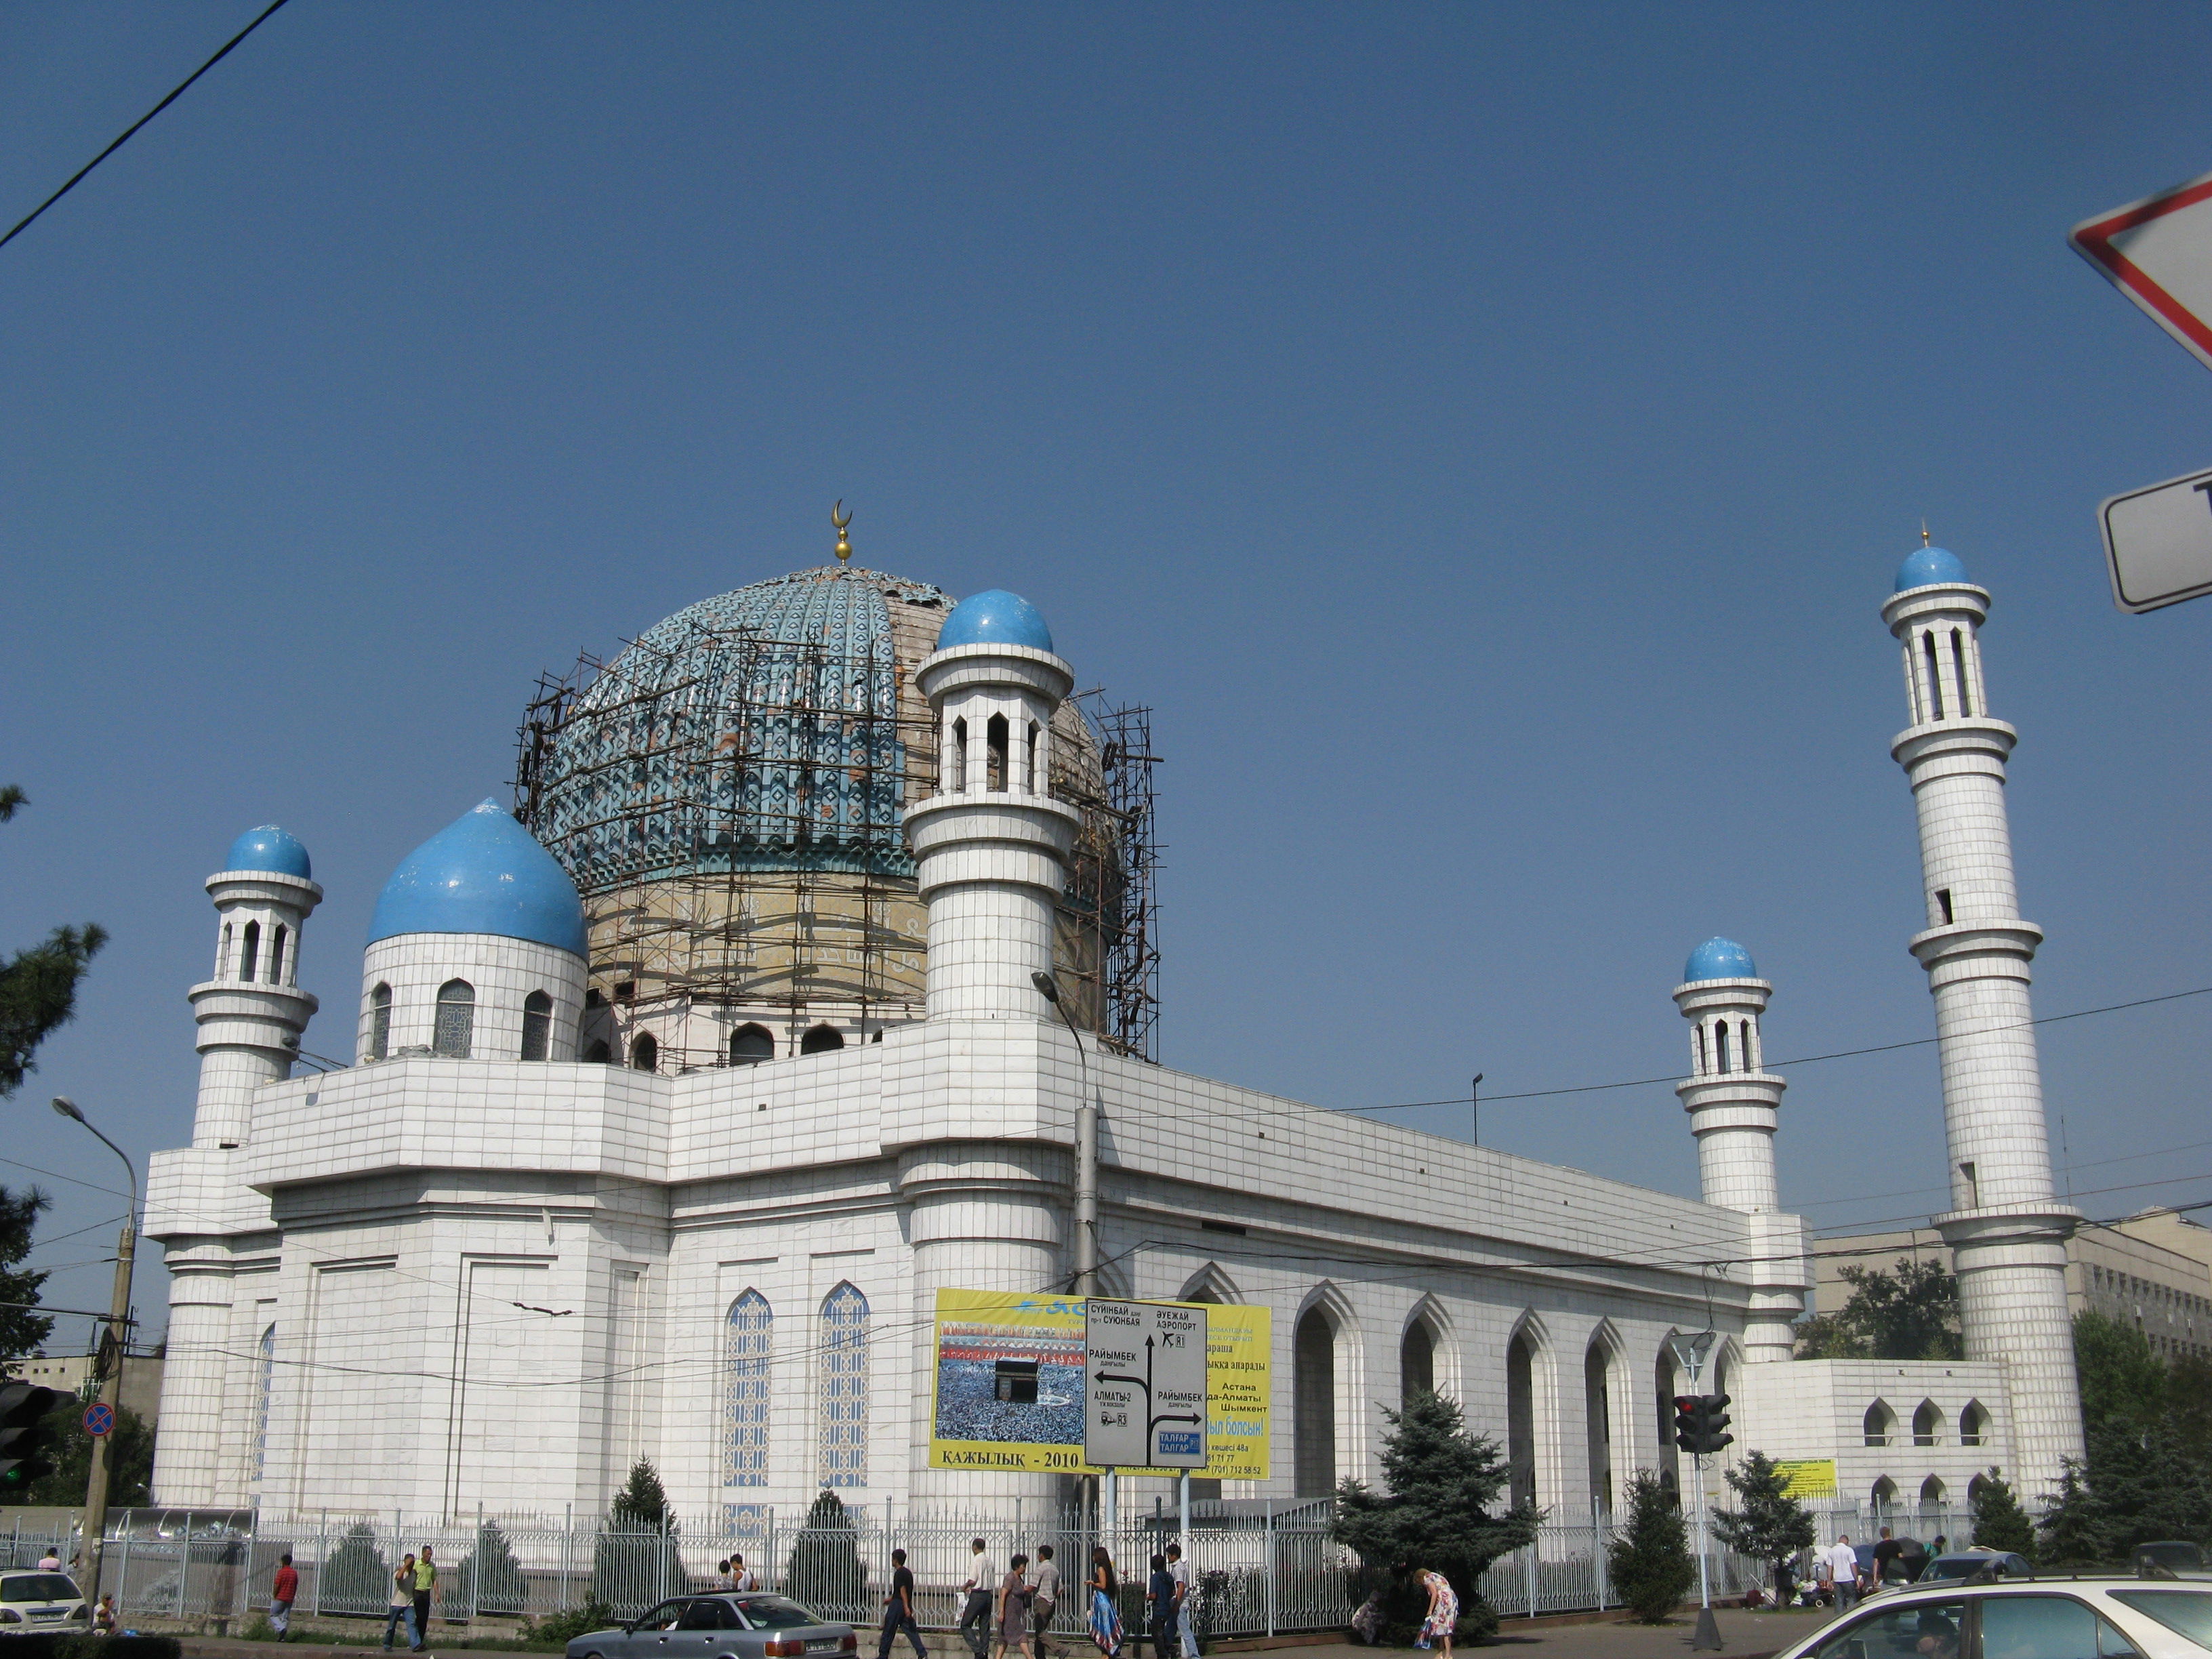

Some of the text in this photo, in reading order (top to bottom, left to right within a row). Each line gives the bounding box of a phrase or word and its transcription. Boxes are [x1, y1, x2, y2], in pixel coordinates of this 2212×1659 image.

[1090, 1304, 1129, 1316] СҮЙІНБАЙ
[1156, 1310, 1189, 1321] ӘУЕЖАЙ
[1103, 1315, 1141, 1326] СУЮНБАЯ
[1155, 1320, 1197, 1331] АЭРОПОРТ
[1088, 1349, 1137, 1361] РАЙЫМБЕК
[1231, 1361, 1265, 1373] апарады
[1223, 1383, 1256, 1391] Астана
[1094, 1391, 1131, 1402] АЛМАТЫ-2
[1158, 1389, 1203, 1402] РАЙЫМБЕК
[1221, 1404, 1267, 1413] Шымкент
[1226, 1416, 1263, 1436] болсын!
[1160, 1443, 1189, 1452] ТАЛГАР
[942, 1450, 1025, 1469] ҚАЖЫЛЫҚ
[1044, 1452, 1079, 1468] 2010
[1211, 1466, 1229, 1475] (701)
